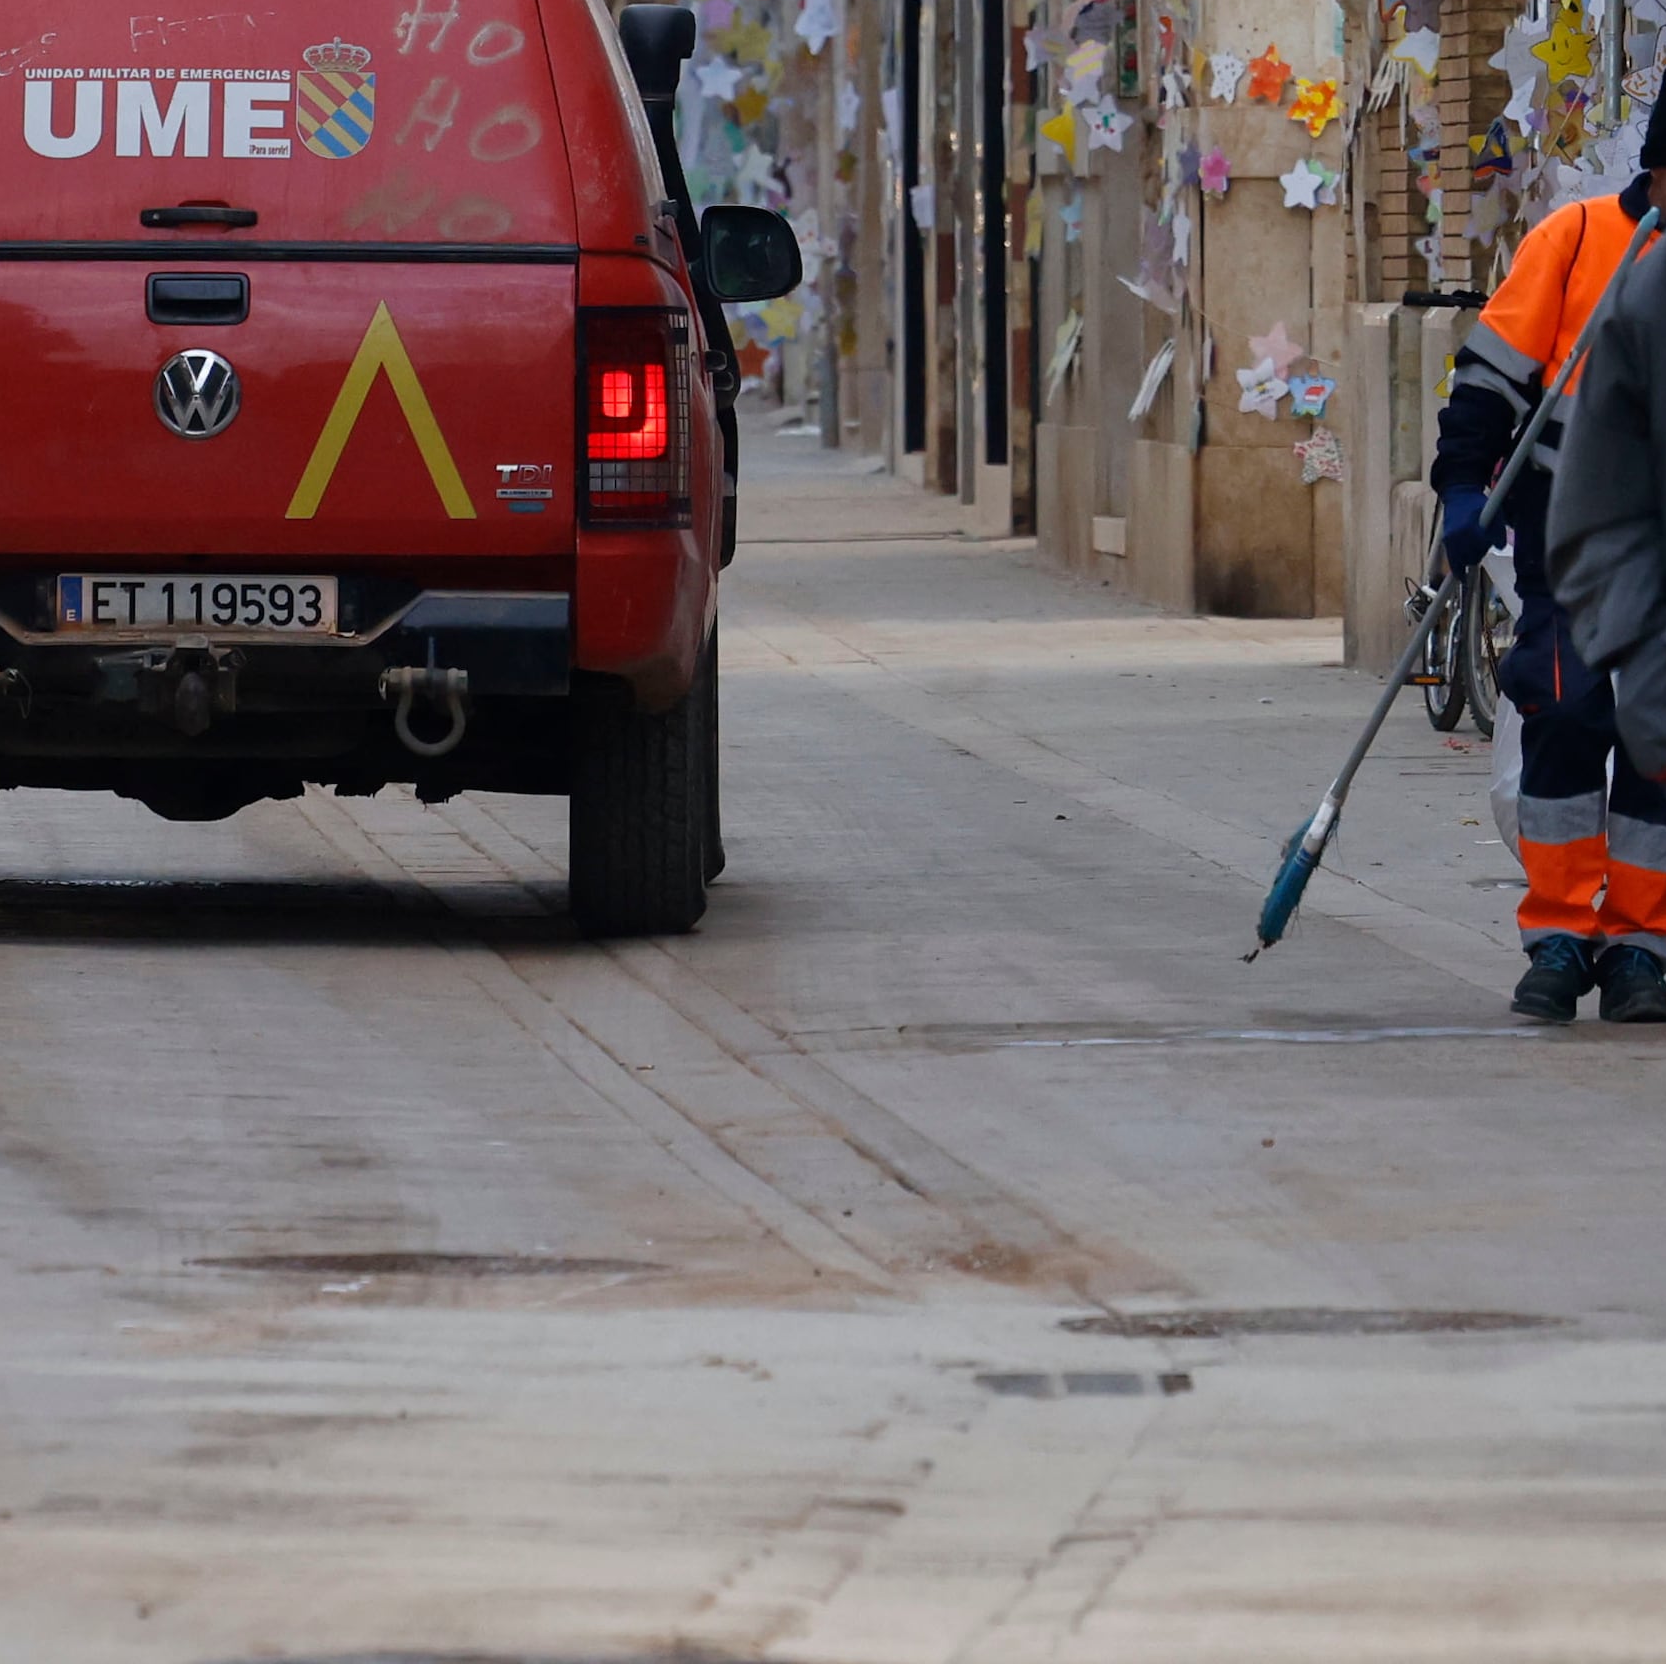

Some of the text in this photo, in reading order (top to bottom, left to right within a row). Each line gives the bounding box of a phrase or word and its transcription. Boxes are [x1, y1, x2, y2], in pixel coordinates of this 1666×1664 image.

[25, 68, 291, 80] UNIDAD MILITAR DE EMERGENCIAS
[23, 80, 291, 159] UME
[496, 464, 552, 483] TDI
[92, 581, 322, 627] ET 119593
